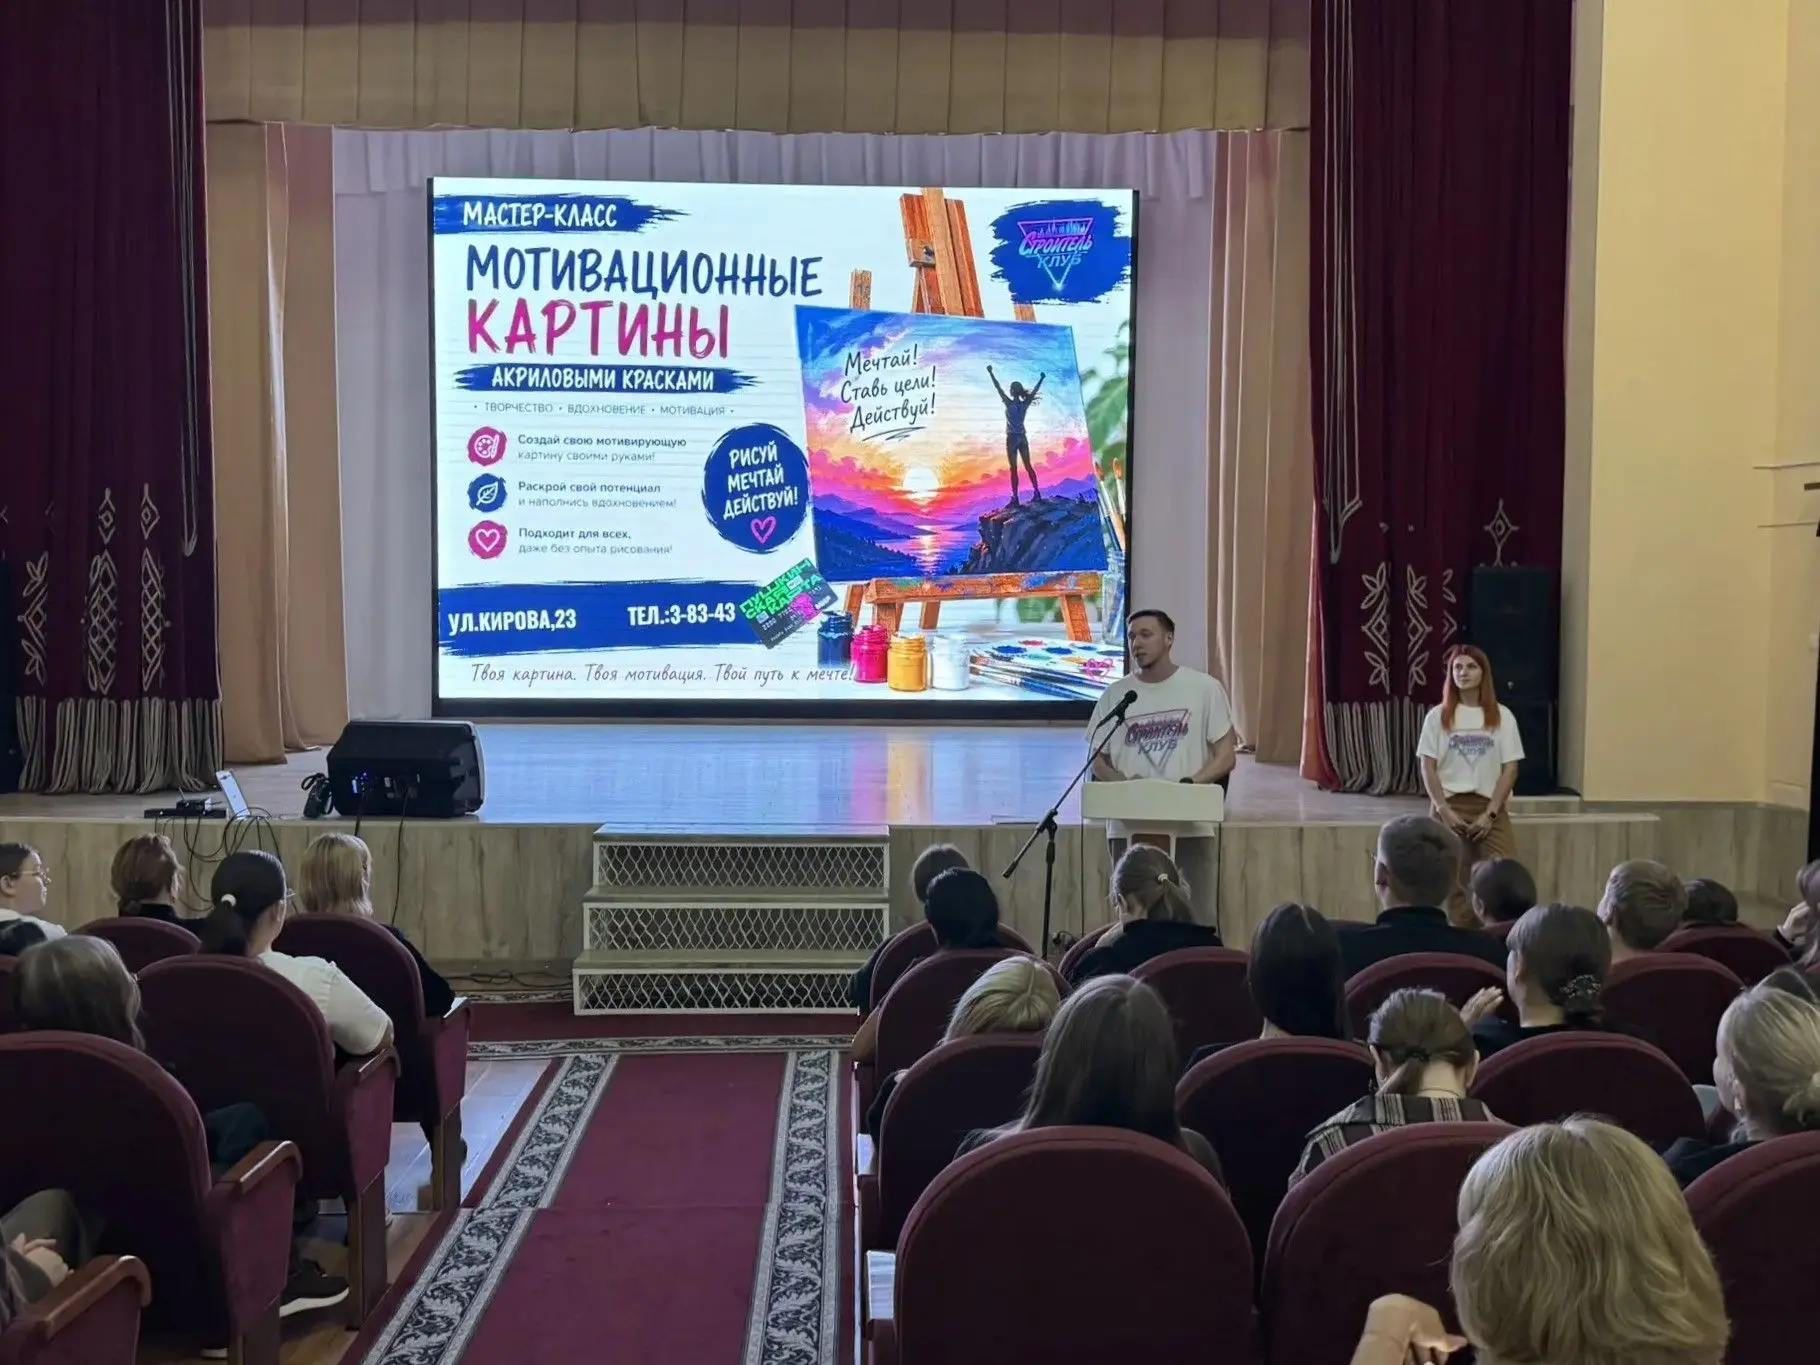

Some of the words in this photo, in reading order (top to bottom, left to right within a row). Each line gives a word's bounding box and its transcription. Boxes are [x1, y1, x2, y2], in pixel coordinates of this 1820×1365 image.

[463, 202, 617, 228] МАСТЕР-КЛАСС
[466, 244, 823, 299] МОТИВАЦИОННЫЕ
[1037, 253, 1082, 268] КЛУБ
[468, 298, 729, 359] КАРТИНЫ
[845, 343, 918, 376] Мечтай!
[491, 367, 615, 389] АКРИЛОВЫМИ
[622, 369, 714, 391] КРАСКАМИ
[841, 377, 888, 403] Ставь
[894, 365, 936, 397] цели!
[484, 402, 553, 413] ТВОРЧЕСТВО
[567, 403, 646, 415] ВДОХНОВЕНИЕ
[660, 405, 725, 417] МОТИВАЦИЯ
[850, 392, 935, 433] Действуй!
[518, 434, 560, 446] Создай
[563, 436, 593, 446] свою
[596, 437, 687, 449] мотивирующую
[518, 452, 563, 463] картину
[566, 452, 608, 461] своими
[611, 452, 656, 463] руками!
[729, 440, 778, 469] РИСУЙ
[518, 481, 566, 493] Раскрой
[569, 482, 597, 492] свой
[600, 483, 661, 494] потенциал
[727, 463, 784, 493] МЕЧТАЙ
[518, 499, 526, 507] и
[529, 499, 589, 507] наполнись
[592, 499, 677, 508] вдохновением!
[723, 485, 798, 520] ДЕЙСТВУЙ!
[518, 527, 575, 539] Подходит
[578, 530, 599, 539] для
[518, 544, 548, 554] даже
[550, 543, 570, 553] без
[573, 545, 607, 554] опыта
[610, 544, 673, 555] рисования!
[448, 608, 577, 636] УЛ.КИРОВА,23
[627, 602, 736, 627] ТЕЛ.:3-83-43
[471, 663, 505, 682] Твоя
[512, 669, 577, 688] картина.
[585, 663, 618, 682] Твоя
[625, 663, 706, 685] мотивация.
[715, 663, 747, 681] Твой
[754, 669, 784, 687] путь
[791, 669, 800, 681] к
[806, 663, 855, 682] мечте!
